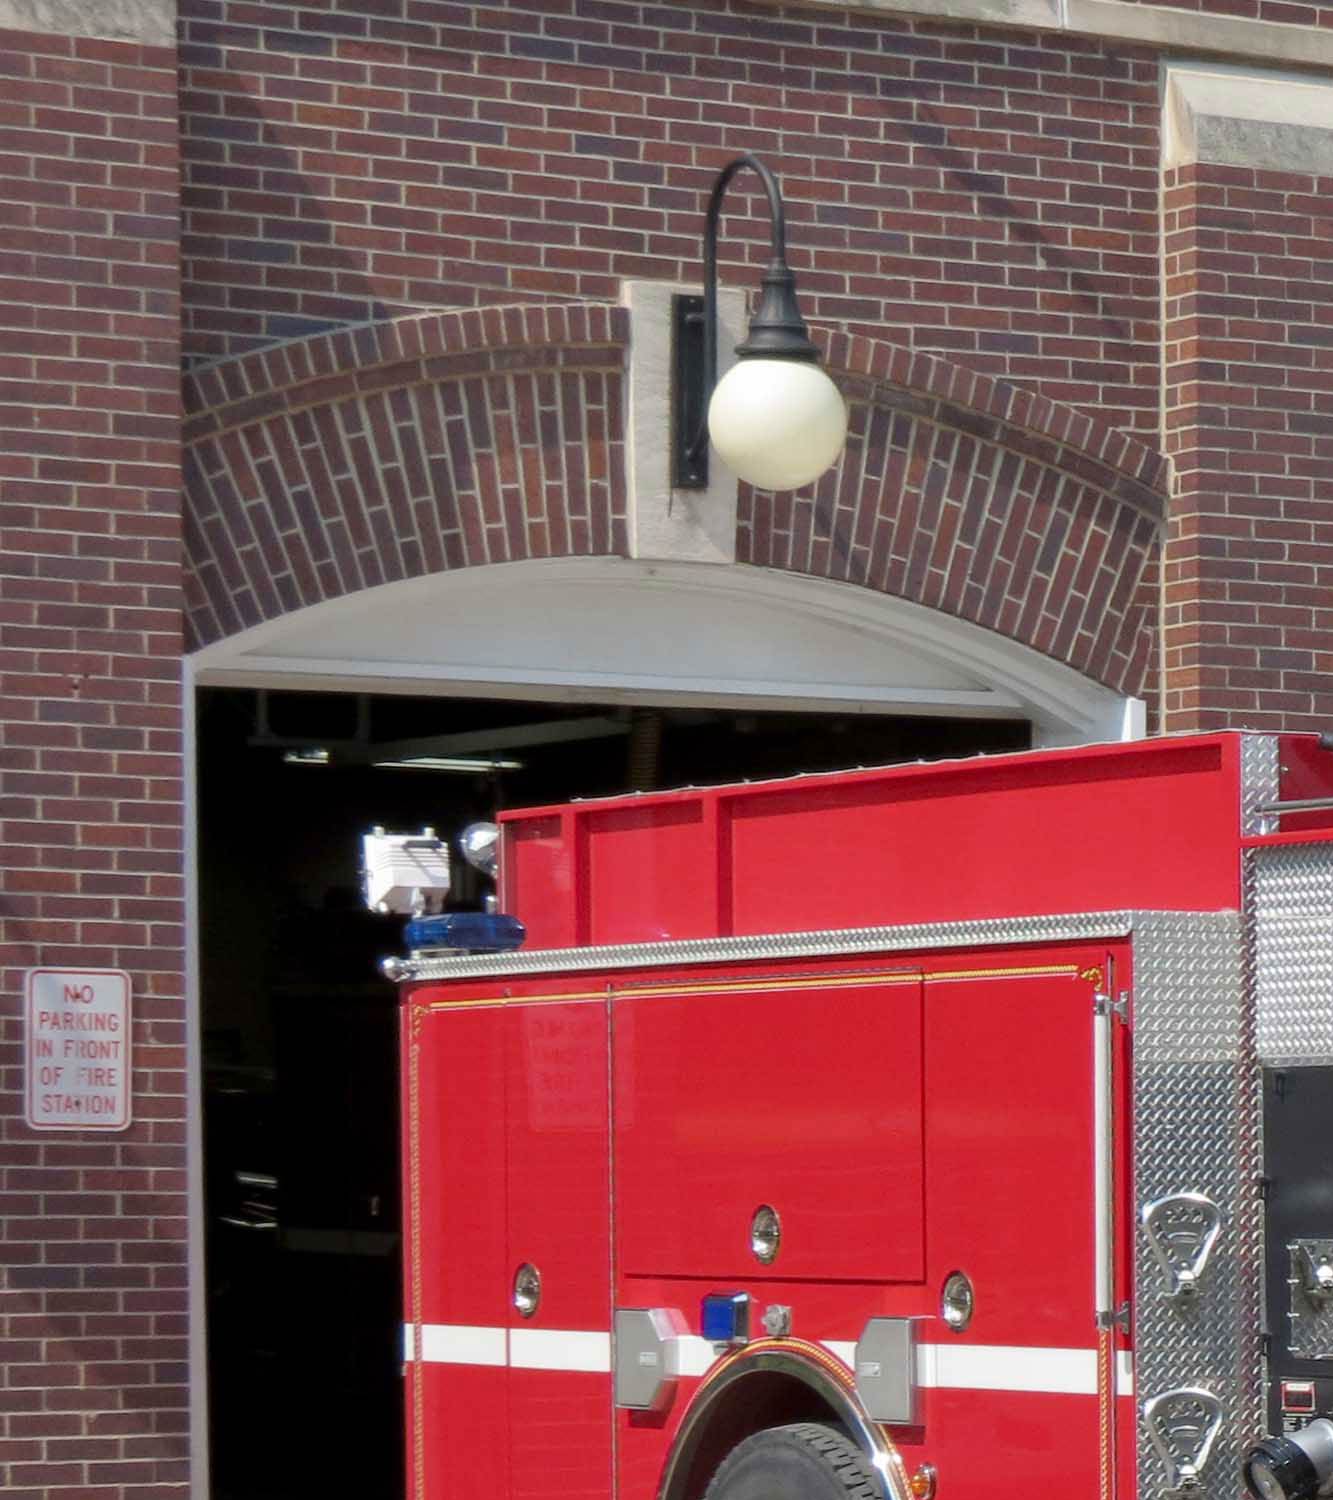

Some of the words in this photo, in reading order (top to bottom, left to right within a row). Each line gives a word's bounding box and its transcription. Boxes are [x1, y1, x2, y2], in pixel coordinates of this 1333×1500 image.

[63, 984, 95, 1004] NO
[39, 1011, 120, 1032] PARKING
[35, 1039, 54, 1058] IN
[63, 1039, 121, 1060] FRONT
[40, 1066, 64, 1086] OF
[78, 1067, 118, 1087] FIRE
[41, 1094, 116, 1115] STATION
